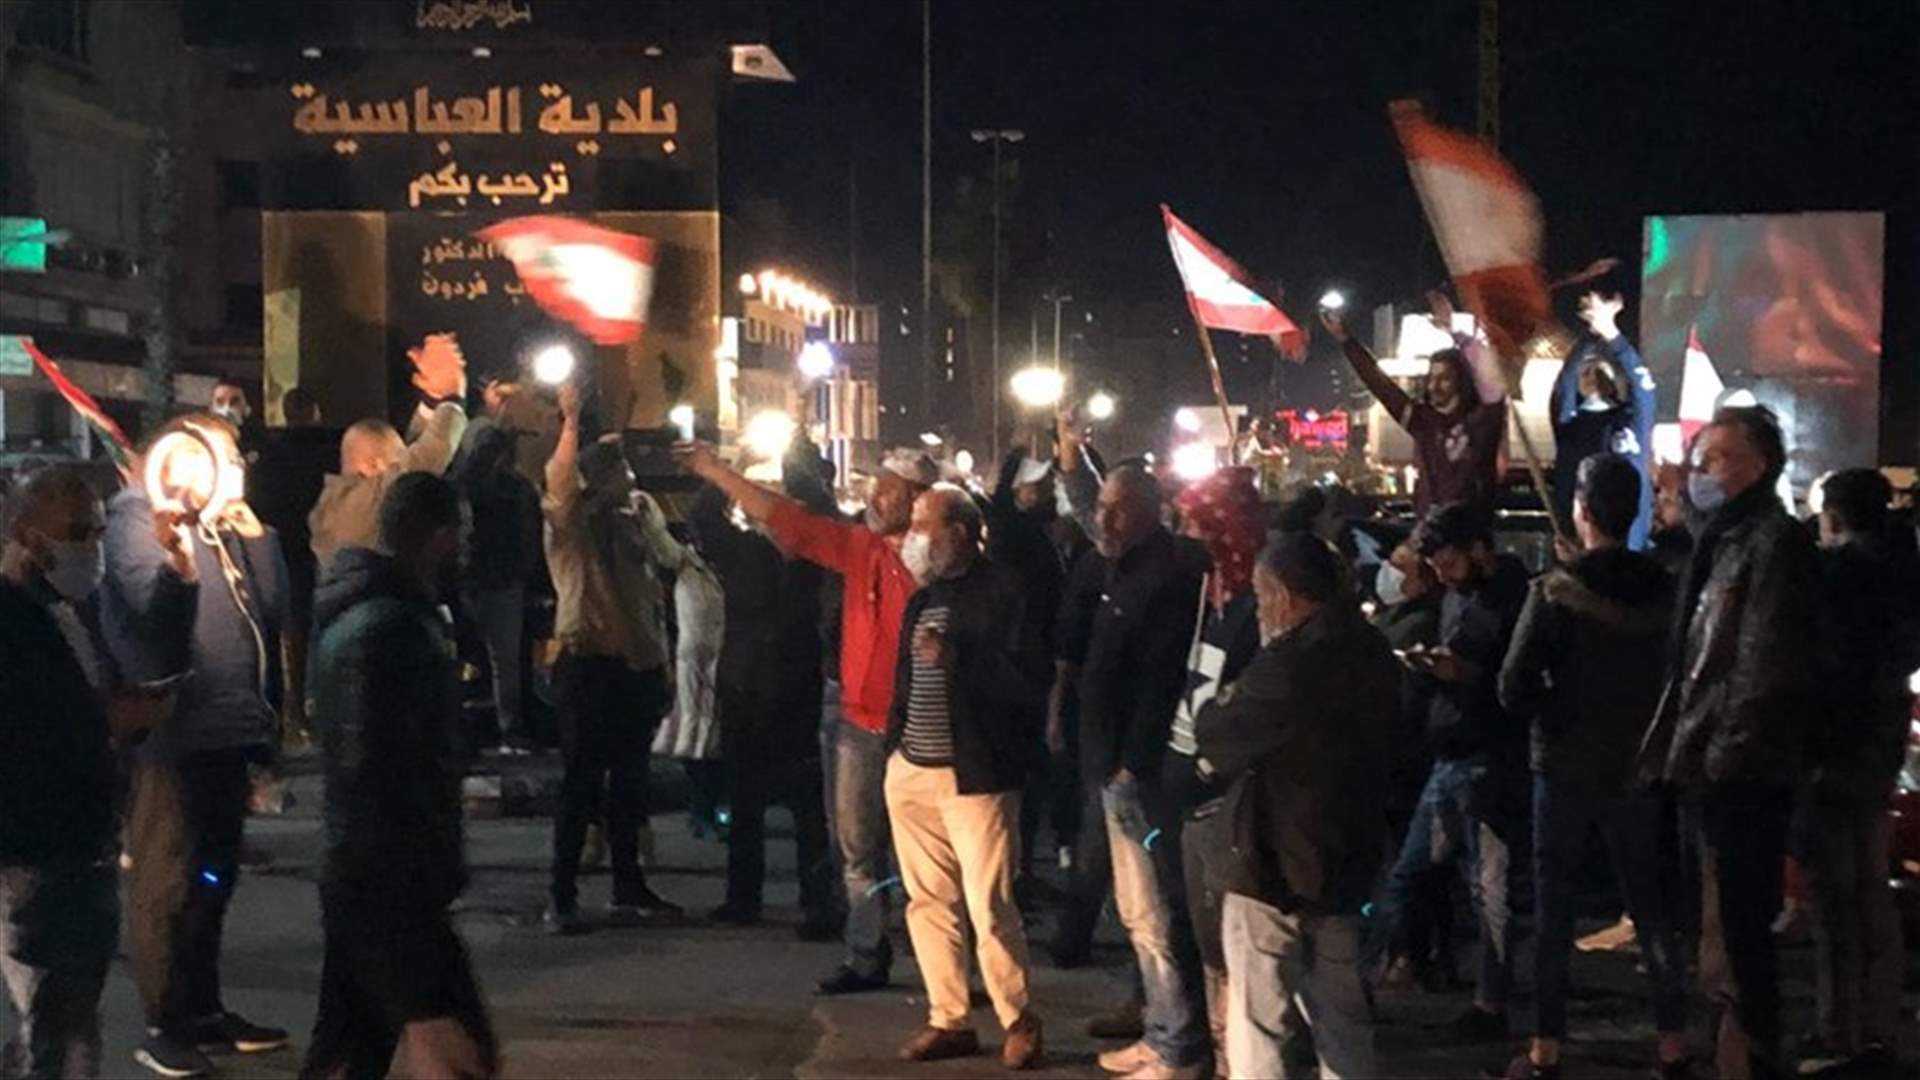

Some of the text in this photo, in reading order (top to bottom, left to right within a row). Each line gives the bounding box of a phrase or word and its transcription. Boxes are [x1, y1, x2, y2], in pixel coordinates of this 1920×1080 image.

[291, 83, 679, 154] بلدية العباسية
[409, 161, 570, 207] ترحب بكم
[422, 237, 494, 264] الدكتور
